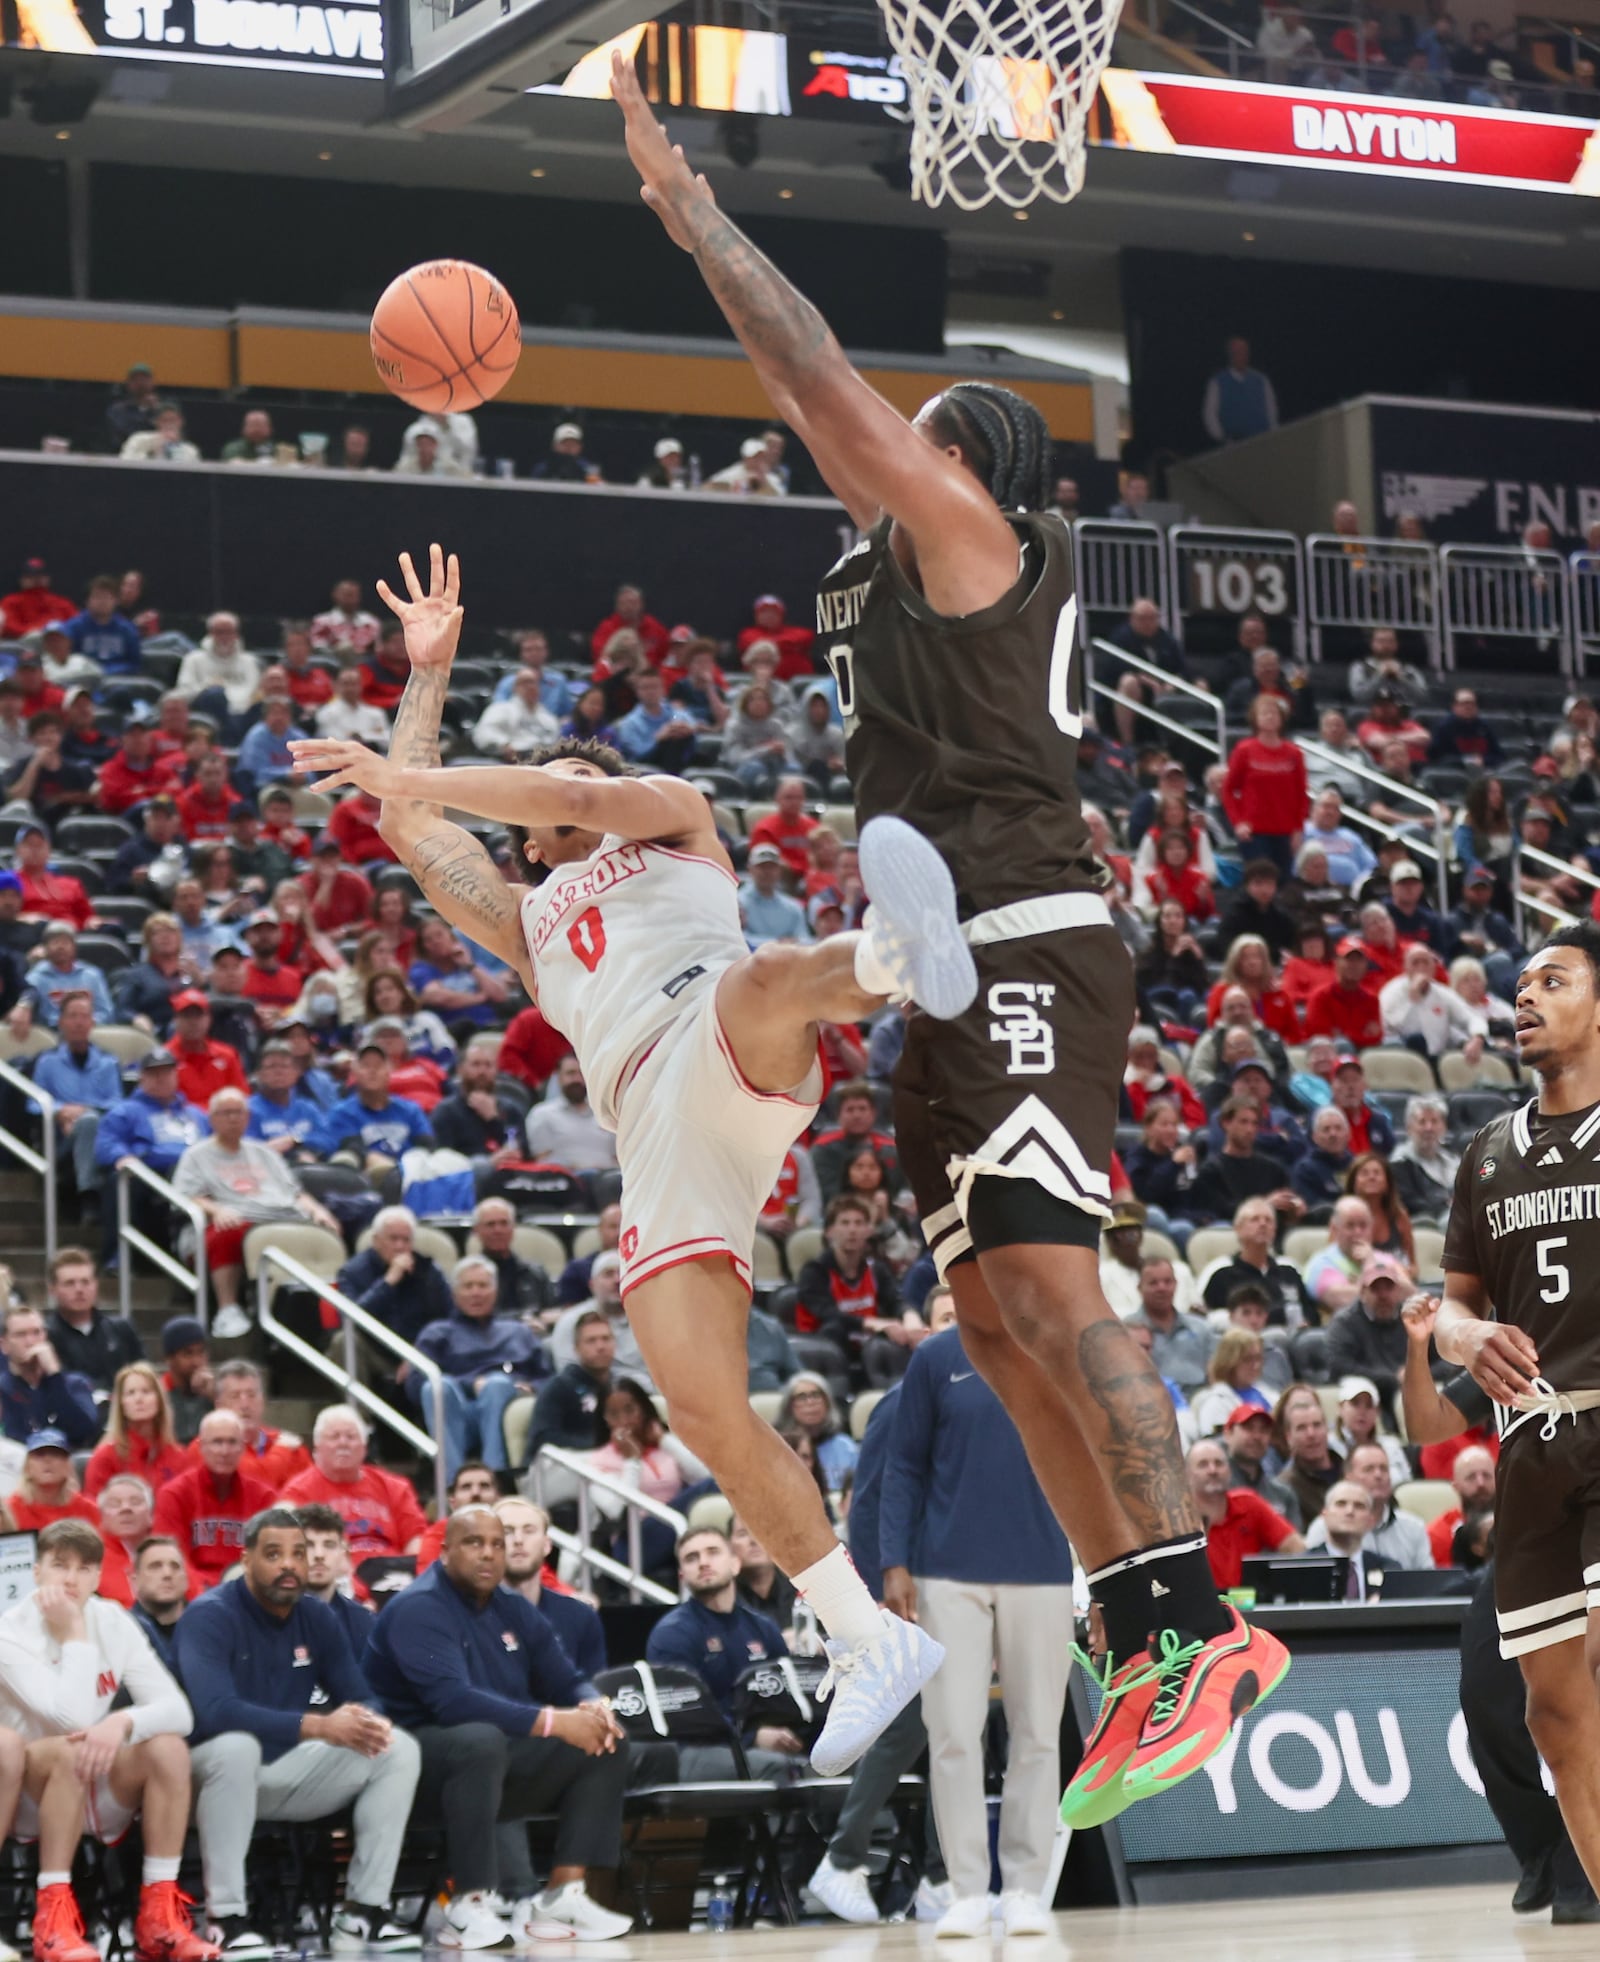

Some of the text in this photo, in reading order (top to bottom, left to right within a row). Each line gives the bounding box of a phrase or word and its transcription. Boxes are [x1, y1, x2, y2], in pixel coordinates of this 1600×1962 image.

[104, 0, 185, 43] ST.
[802, 66, 905, 103] A10
[1291, 104, 1457, 165] DAYTON
[1193, 561, 1288, 615] 103
[533, 843, 647, 955] DAYTON
[567, 905, 607, 973] 0
[1536, 1236, 1571, 1304] 5
